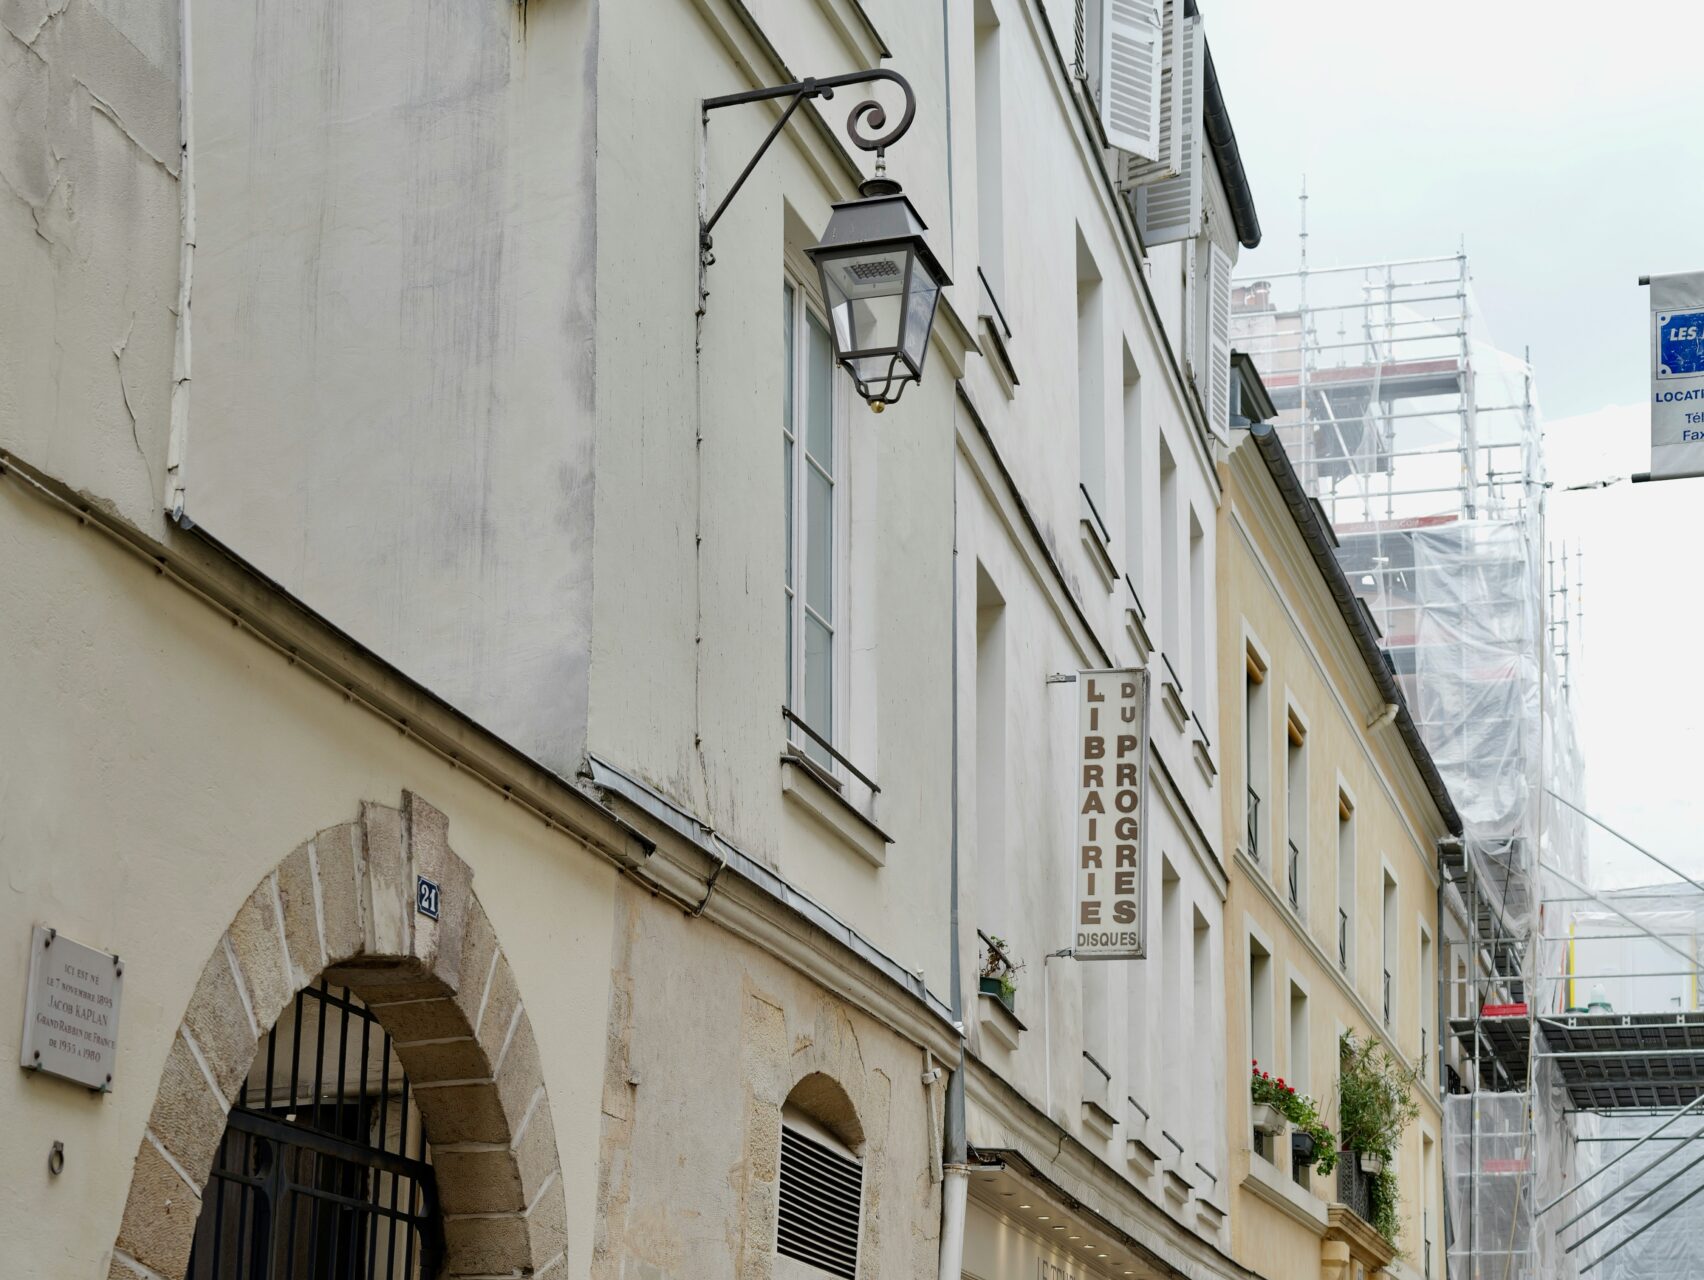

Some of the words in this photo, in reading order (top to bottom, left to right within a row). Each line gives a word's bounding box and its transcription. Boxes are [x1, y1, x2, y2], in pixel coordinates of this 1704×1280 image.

[1670, 326, 1697, 341] LES
[1121, 682, 1136, 723] DU
[1081, 679, 1106, 925] LIBRAIRIE
[1112, 735, 1138, 925] PROGRES
[421, 884, 436, 912] 21
[1077, 931, 1137, 947] DISQUES
[64, 963, 75, 975] ICI
[77, 968, 88, 981] EST
[47, 976, 54, 987] LE
[62, 983, 95, 1002] NOVEMBRE
[97, 994, 113, 1009] 1895
